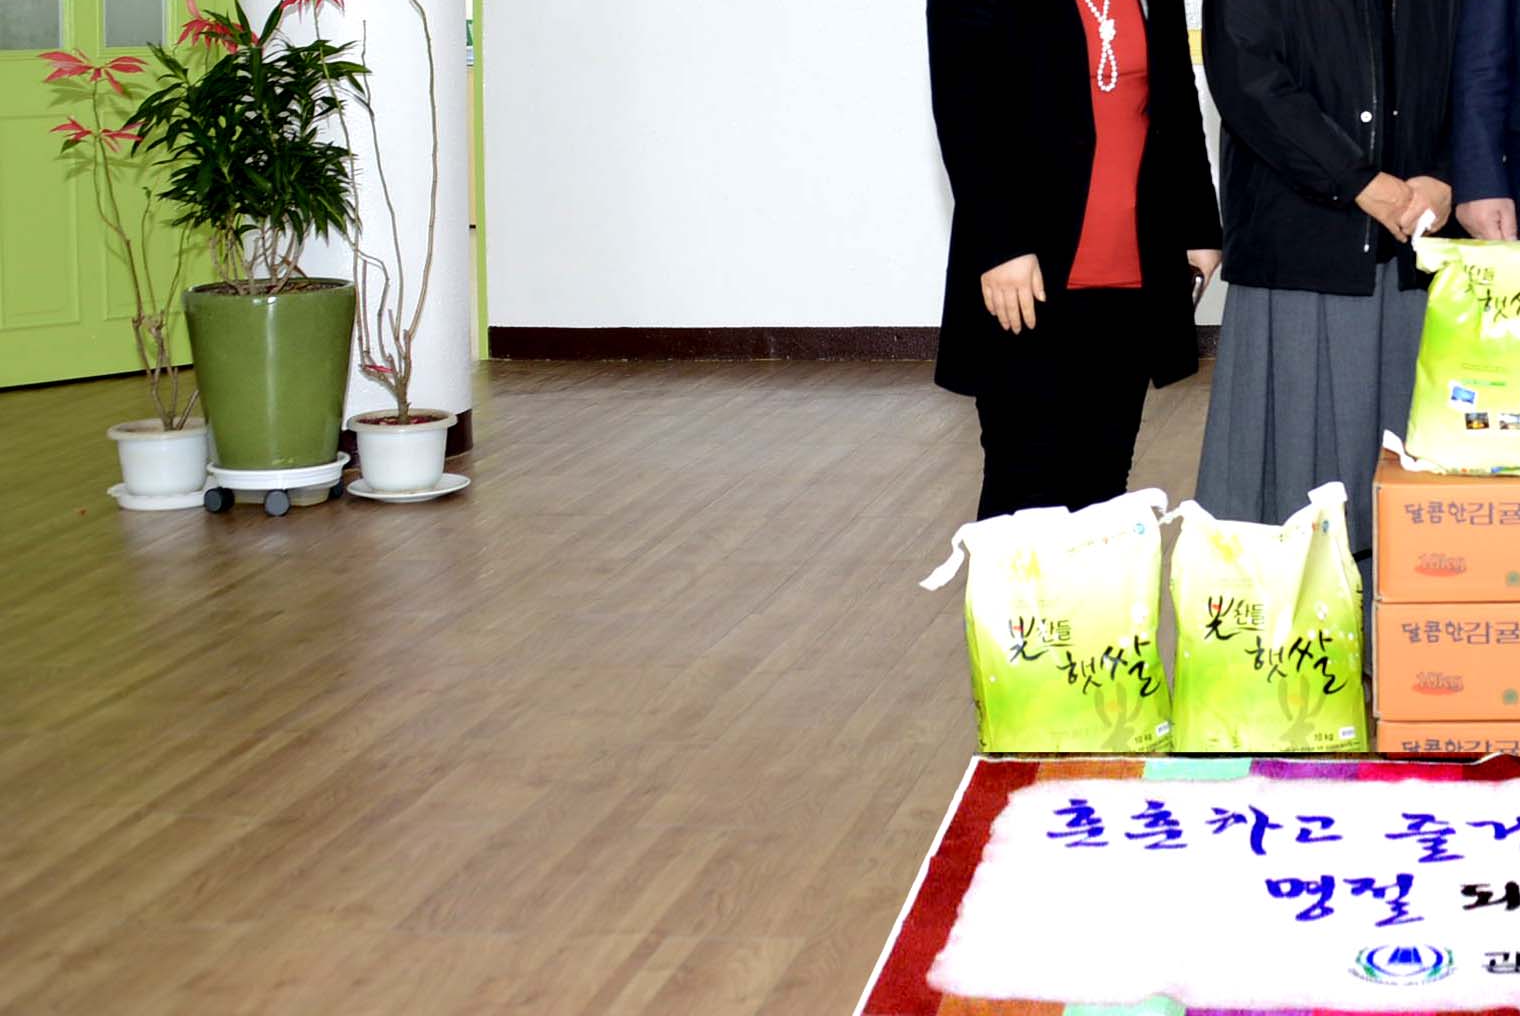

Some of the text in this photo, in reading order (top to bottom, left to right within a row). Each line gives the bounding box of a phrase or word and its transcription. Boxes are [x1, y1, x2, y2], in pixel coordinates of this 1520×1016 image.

[1056, 634, 1161, 698] 햇쌀
[1245, 631, 1348, 696] 햇쌀
[1265, 872, 1425, 927] 명절
